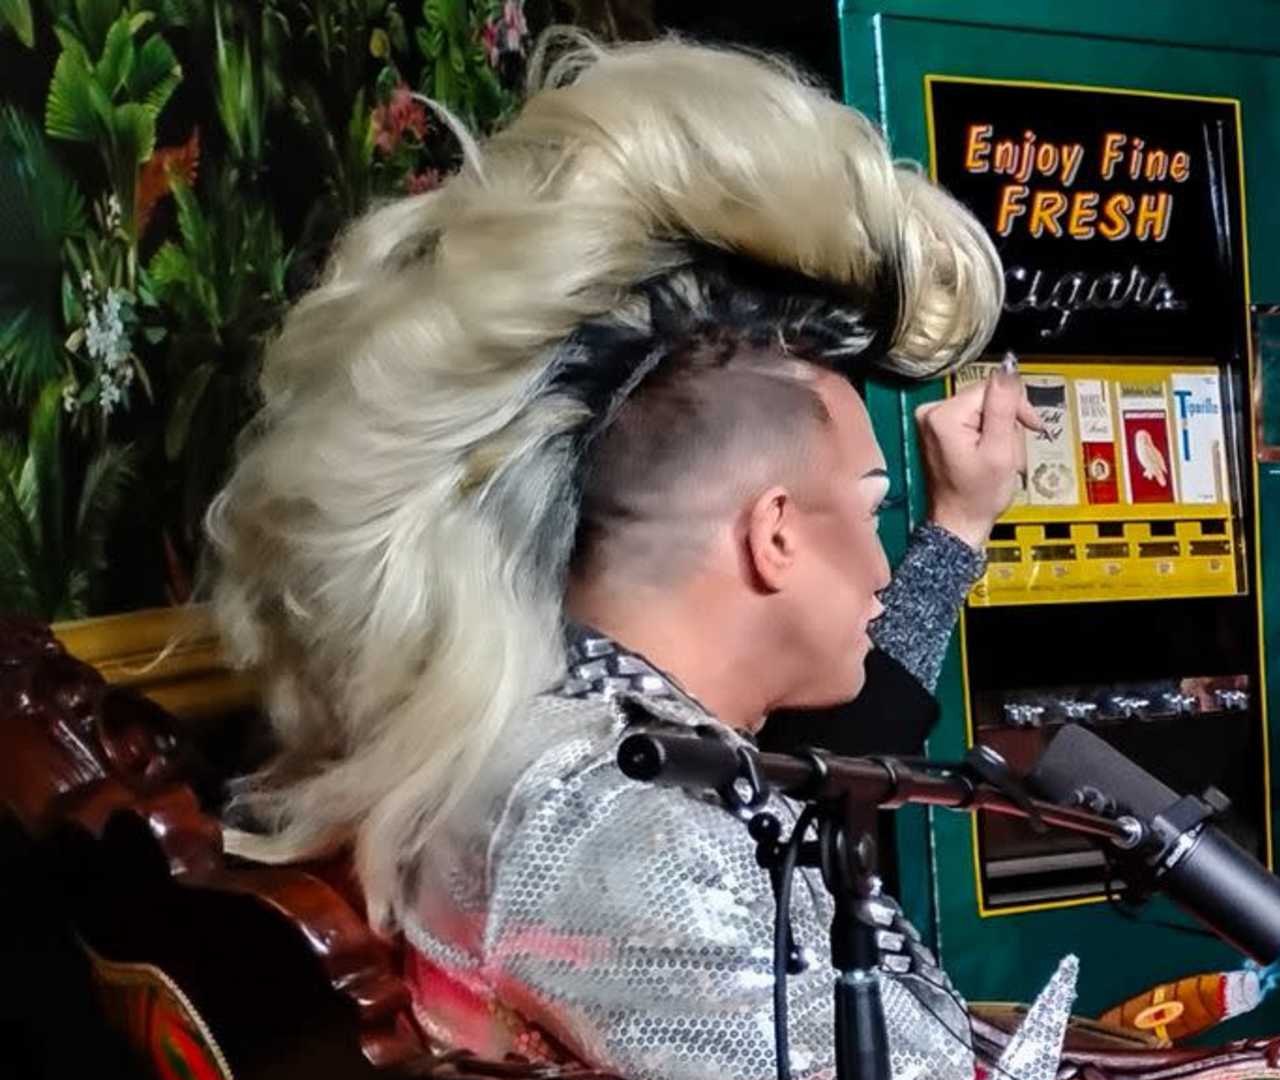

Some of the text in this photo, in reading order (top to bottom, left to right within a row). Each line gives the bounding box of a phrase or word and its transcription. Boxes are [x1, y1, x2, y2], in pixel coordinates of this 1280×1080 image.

[965, 123, 1191, 187] Enjoy Fine
[997, 185, 1173, 242] FRESH
